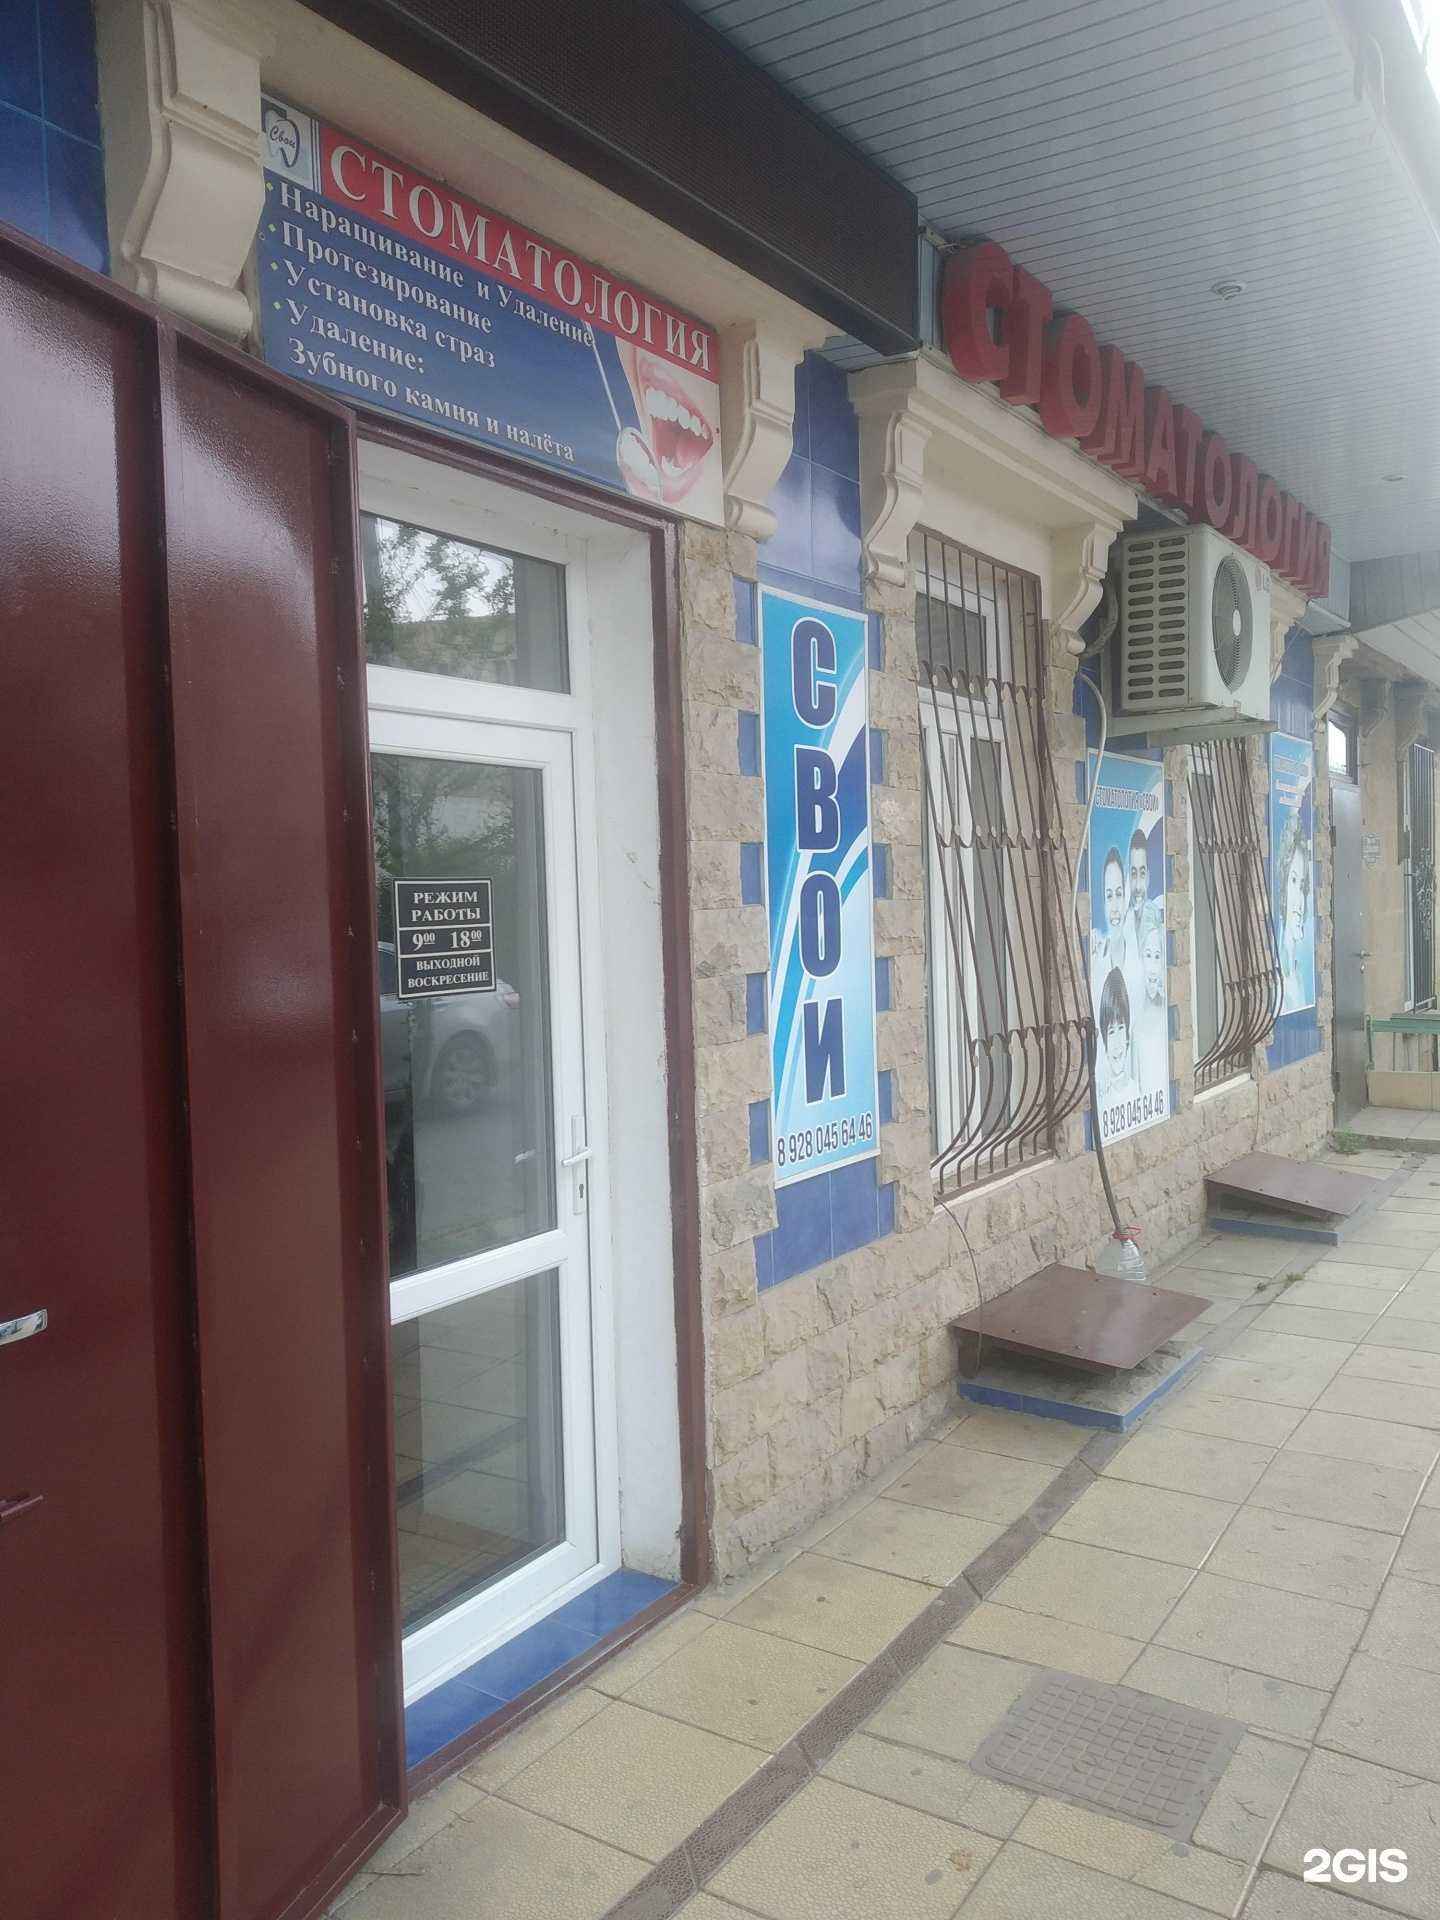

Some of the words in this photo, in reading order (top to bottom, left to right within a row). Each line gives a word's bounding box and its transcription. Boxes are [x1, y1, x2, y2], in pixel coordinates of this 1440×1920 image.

[281, 181, 465, 288] Наращивание
[477, 280, 490, 301] и
[496, 284, 594, 348] Удаление
[282, 220, 492, 334] Протезирование
[330, 145, 711, 373] СТОМАТОЛОГИЯ
[283, 258, 428, 341] Установка
[435, 330, 496, 369] страз
[286, 297, 425, 375] Удаление:
[288, 337, 398, 398] Зубного
[405, 386, 480, 428] камня
[486, 416, 499, 435] и
[506, 424, 575, 462] налёта
[942, 240, 1331, 599] СТОМАТОЛОГИЯ
[413, 891, 478, 904] РЕЖИМ
[791, 616, 847, 1105] СВОИ
[411, 907, 480, 922] РАБОТЫ
[408, 971, 489, 988] ВОСКРЕСЕНИЕ
[416, 955, 480, 971] ВЫХОДНОЙ
[777, 1137, 786, 1167] 8
[789, 1130, 813, 1163] 928
[816, 1122, 839, 1154] 045
[841, 1116, 856, 1146] 64
[858, 1112, 873, 1140] 46
[1102, 1109, 1109, 1138] 8
[1110, 1103, 1126, 1135] 928
[1127, 1097, 1142, 1128] 045
[1154, 1089, 1164, 1116] 46
